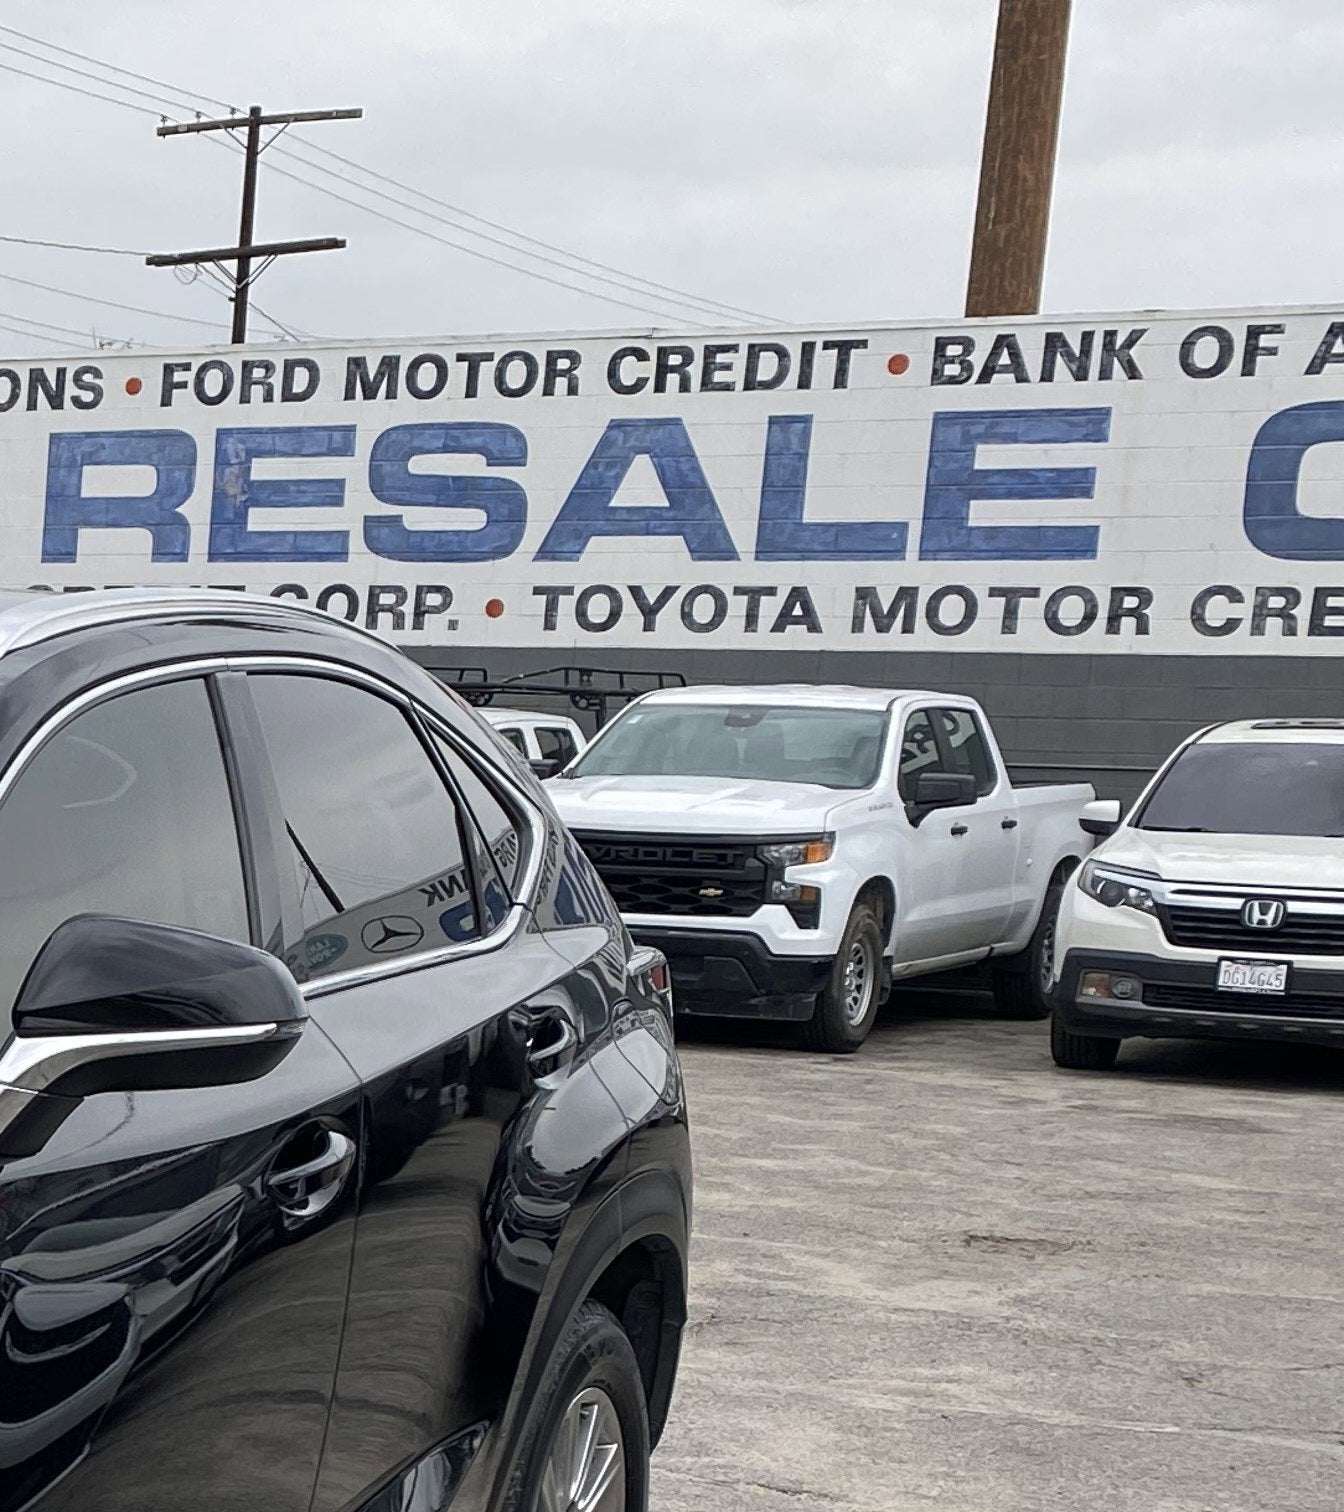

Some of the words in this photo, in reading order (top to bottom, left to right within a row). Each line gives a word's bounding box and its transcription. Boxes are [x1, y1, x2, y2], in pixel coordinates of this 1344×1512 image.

[159, 358, 321, 408] FORD
[343, 349, 582, 402] MOTOR
[607, 339, 869, 396] CREDIT
[930, 328, 1151, 386] BANK
[1178, 323, 1286, 379] OF
[41, 407, 1112, 564] RESALE
[531, 585, 823, 633] TOYOTA
[851, 585, 1154, 636] MOTOR
[1190, 585, 1344, 637] CRE
